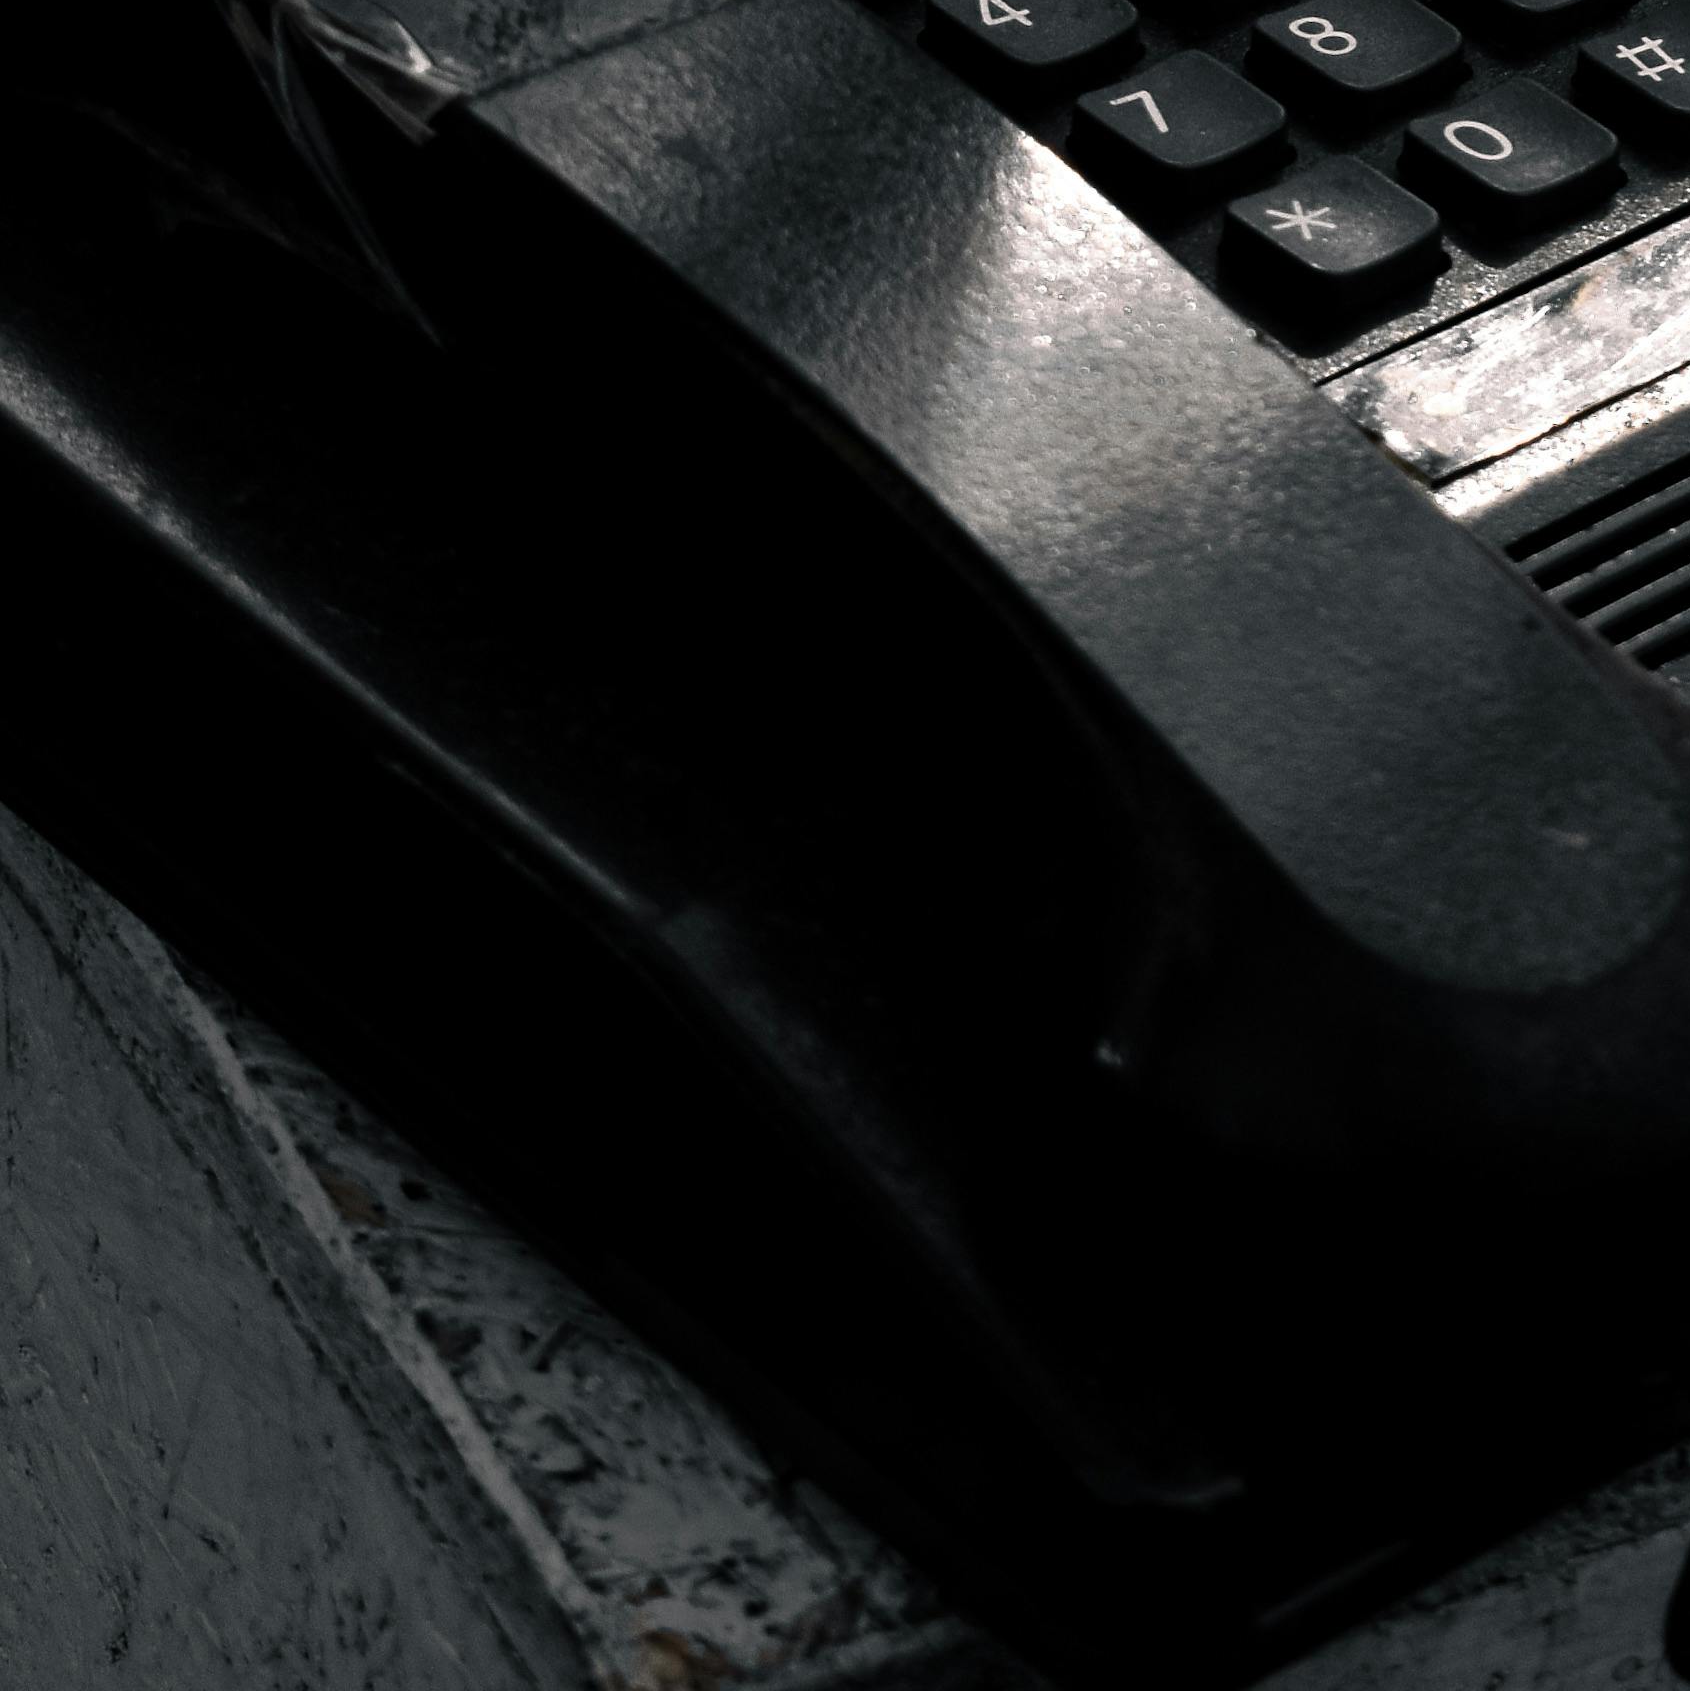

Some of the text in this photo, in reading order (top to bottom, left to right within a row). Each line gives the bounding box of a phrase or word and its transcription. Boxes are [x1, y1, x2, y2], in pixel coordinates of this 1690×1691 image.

[1109, 90, 1169, 134] 7
[1288, 15, 1358, 56] 8
[1443, 119, 1514, 162] 0
[1615, 35, 1686, 82] #
